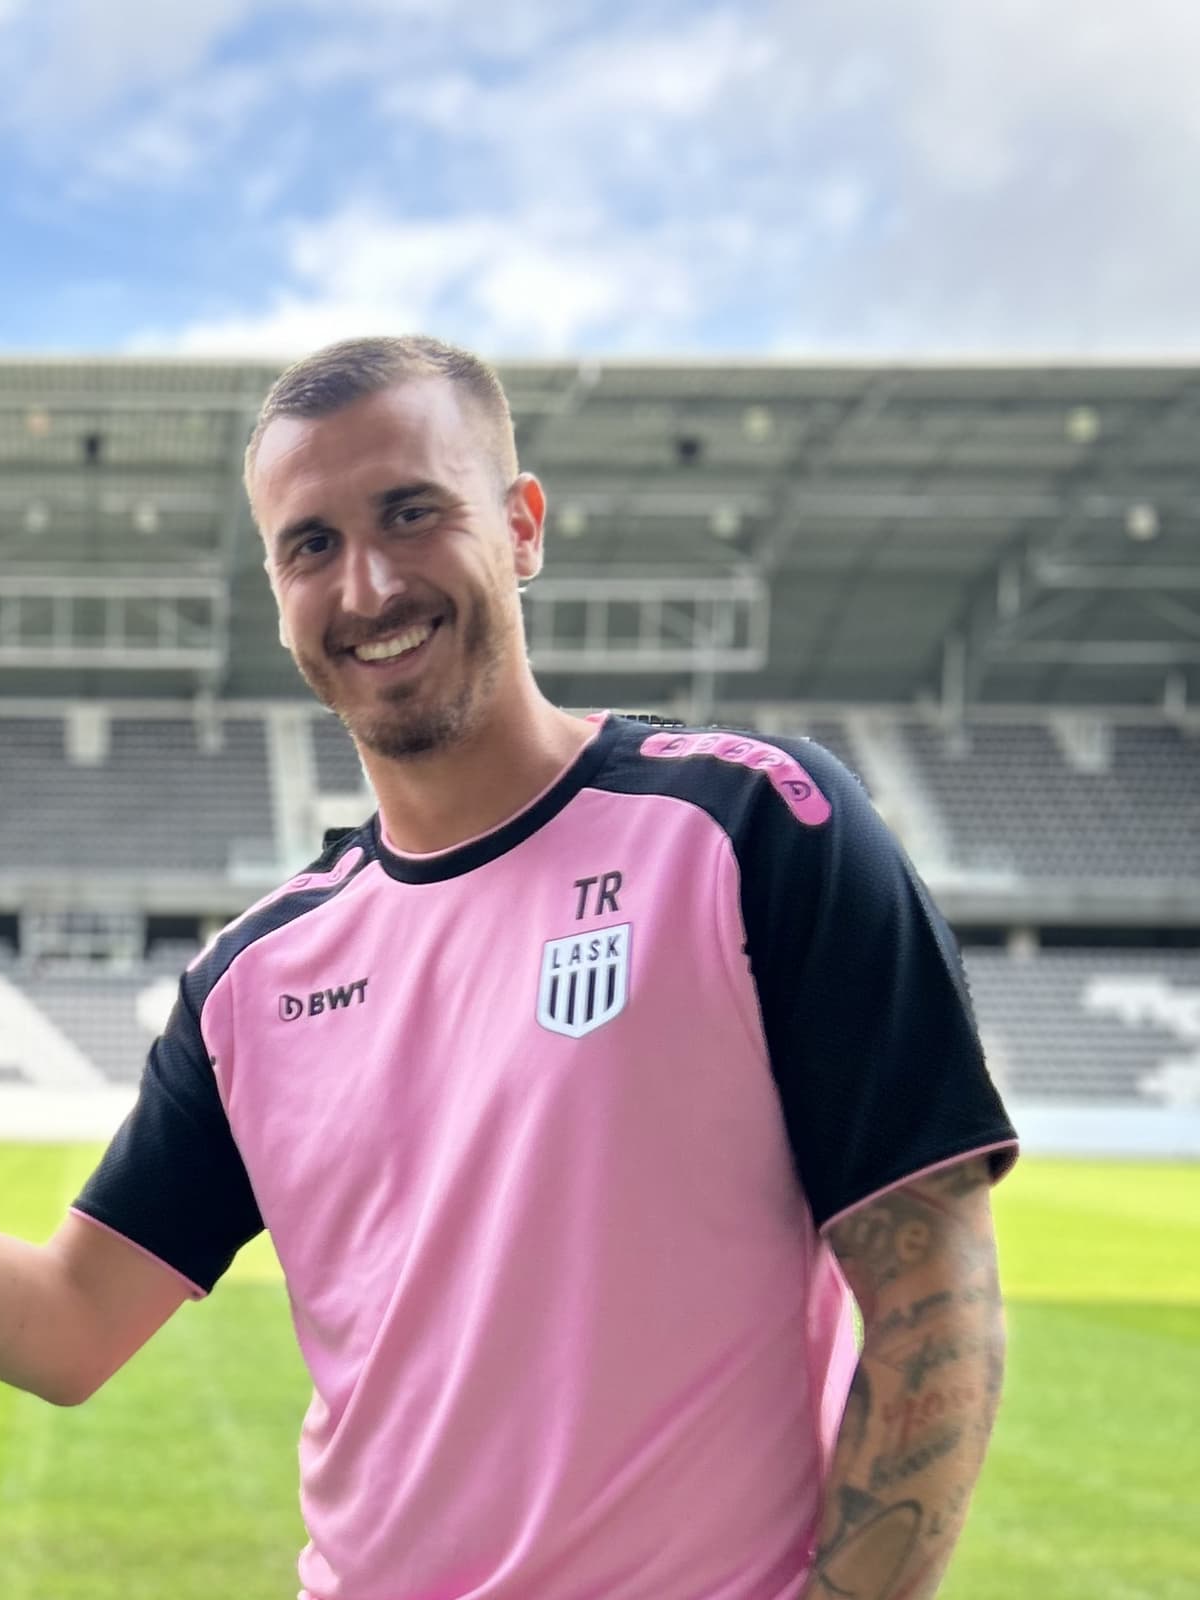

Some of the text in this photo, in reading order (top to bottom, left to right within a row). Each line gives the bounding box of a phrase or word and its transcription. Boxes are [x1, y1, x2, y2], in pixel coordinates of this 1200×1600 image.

[573, 870, 622, 920] TR
[552, 934, 621, 969] LASK
[308, 977, 368, 1016] BWT
